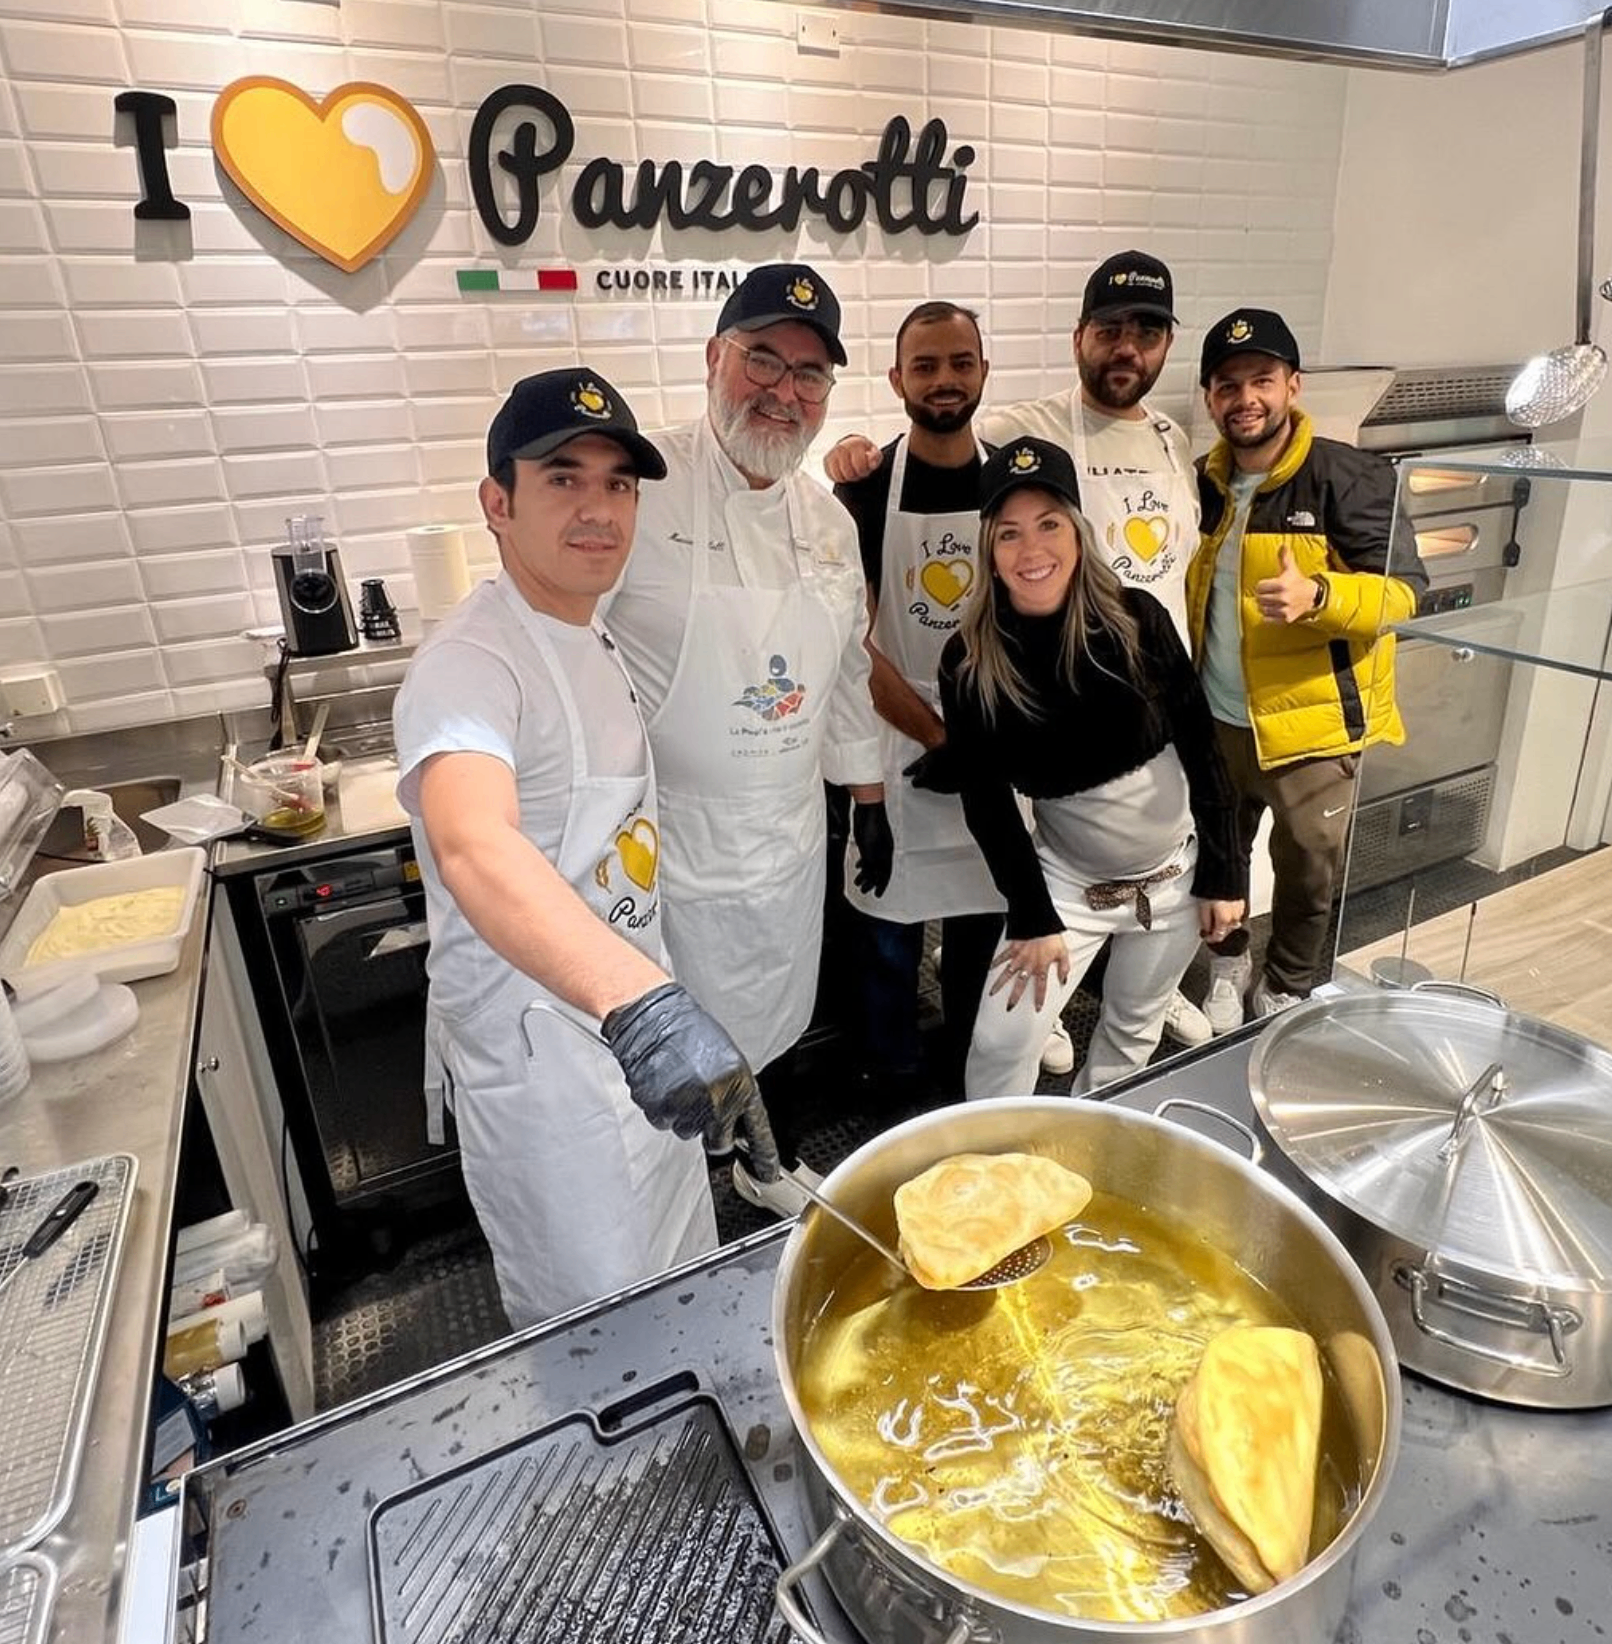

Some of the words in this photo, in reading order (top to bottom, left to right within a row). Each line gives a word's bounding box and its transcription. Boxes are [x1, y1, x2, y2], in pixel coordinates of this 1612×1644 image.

[114, 91, 191, 220] I
[469, 83, 979, 247] Panzerotti
[596, 270, 684, 290] CUORE
[1123, 497, 1132, 514] I
[1137, 490, 1169, 513] Love
[921, 540, 931, 558] I
[936, 532, 972, 556] Love
